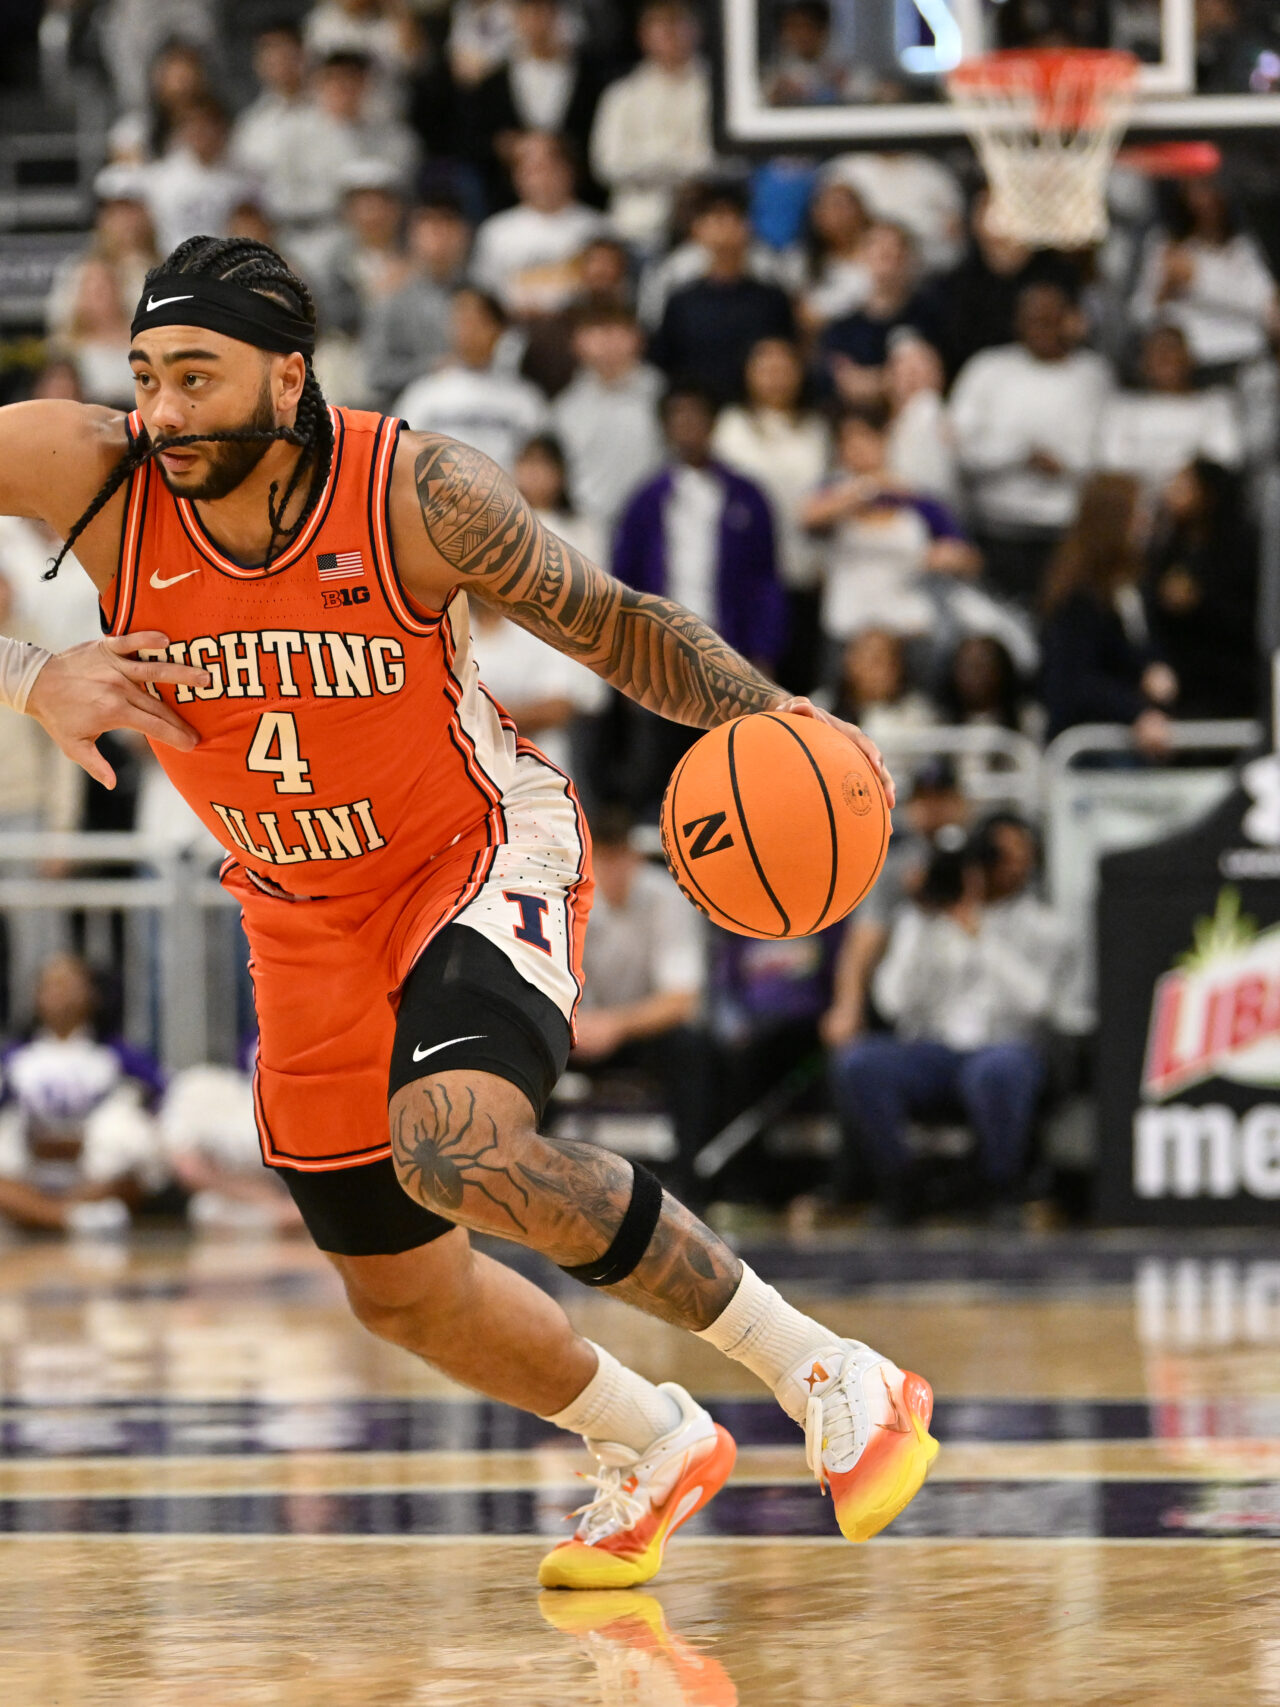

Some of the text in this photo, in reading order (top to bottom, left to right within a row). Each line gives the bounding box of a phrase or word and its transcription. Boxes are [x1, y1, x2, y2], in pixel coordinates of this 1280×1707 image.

[247, 711, 315, 795] 4
[210, 798, 387, 865] ILLINI
[502, 890, 552, 957] I
[1148, 967, 1280, 1084] LIB
